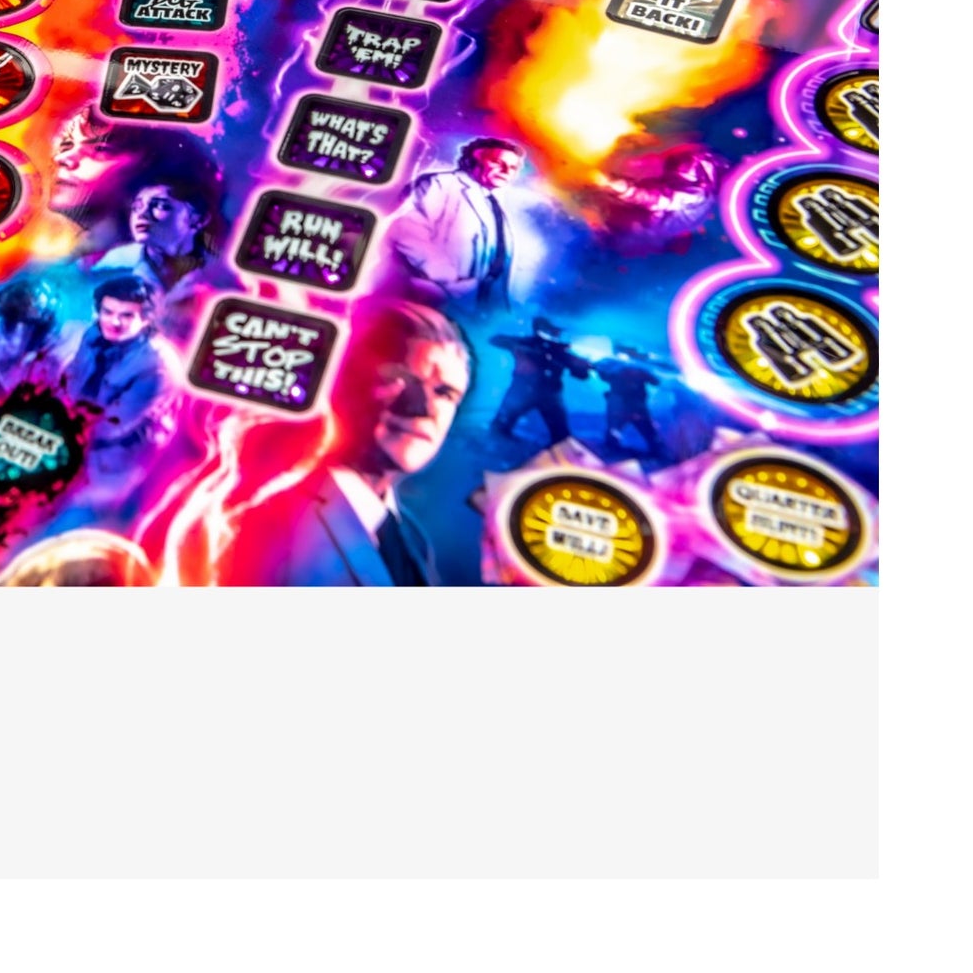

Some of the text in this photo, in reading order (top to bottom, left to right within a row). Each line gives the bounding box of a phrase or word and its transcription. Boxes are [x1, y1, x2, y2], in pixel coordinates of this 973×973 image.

[135, 6, 212, 21] ATTACK
[629, 3, 702, 31] BACK!
[346, 24, 422, 55] TRAP
[126, 58, 202, 76] MYSTERY
[351, 45, 404, 69] 'EM!
[310, 110, 388, 145] WHAT'S
[307, 131, 374, 163] THAT?
[280, 210, 343, 244] RUN
[264, 235, 344, 271] WILL!
[225, 312, 319, 346] CAN'T
[212, 335, 314, 370] STOP
[213, 359, 297, 396] THIS!
